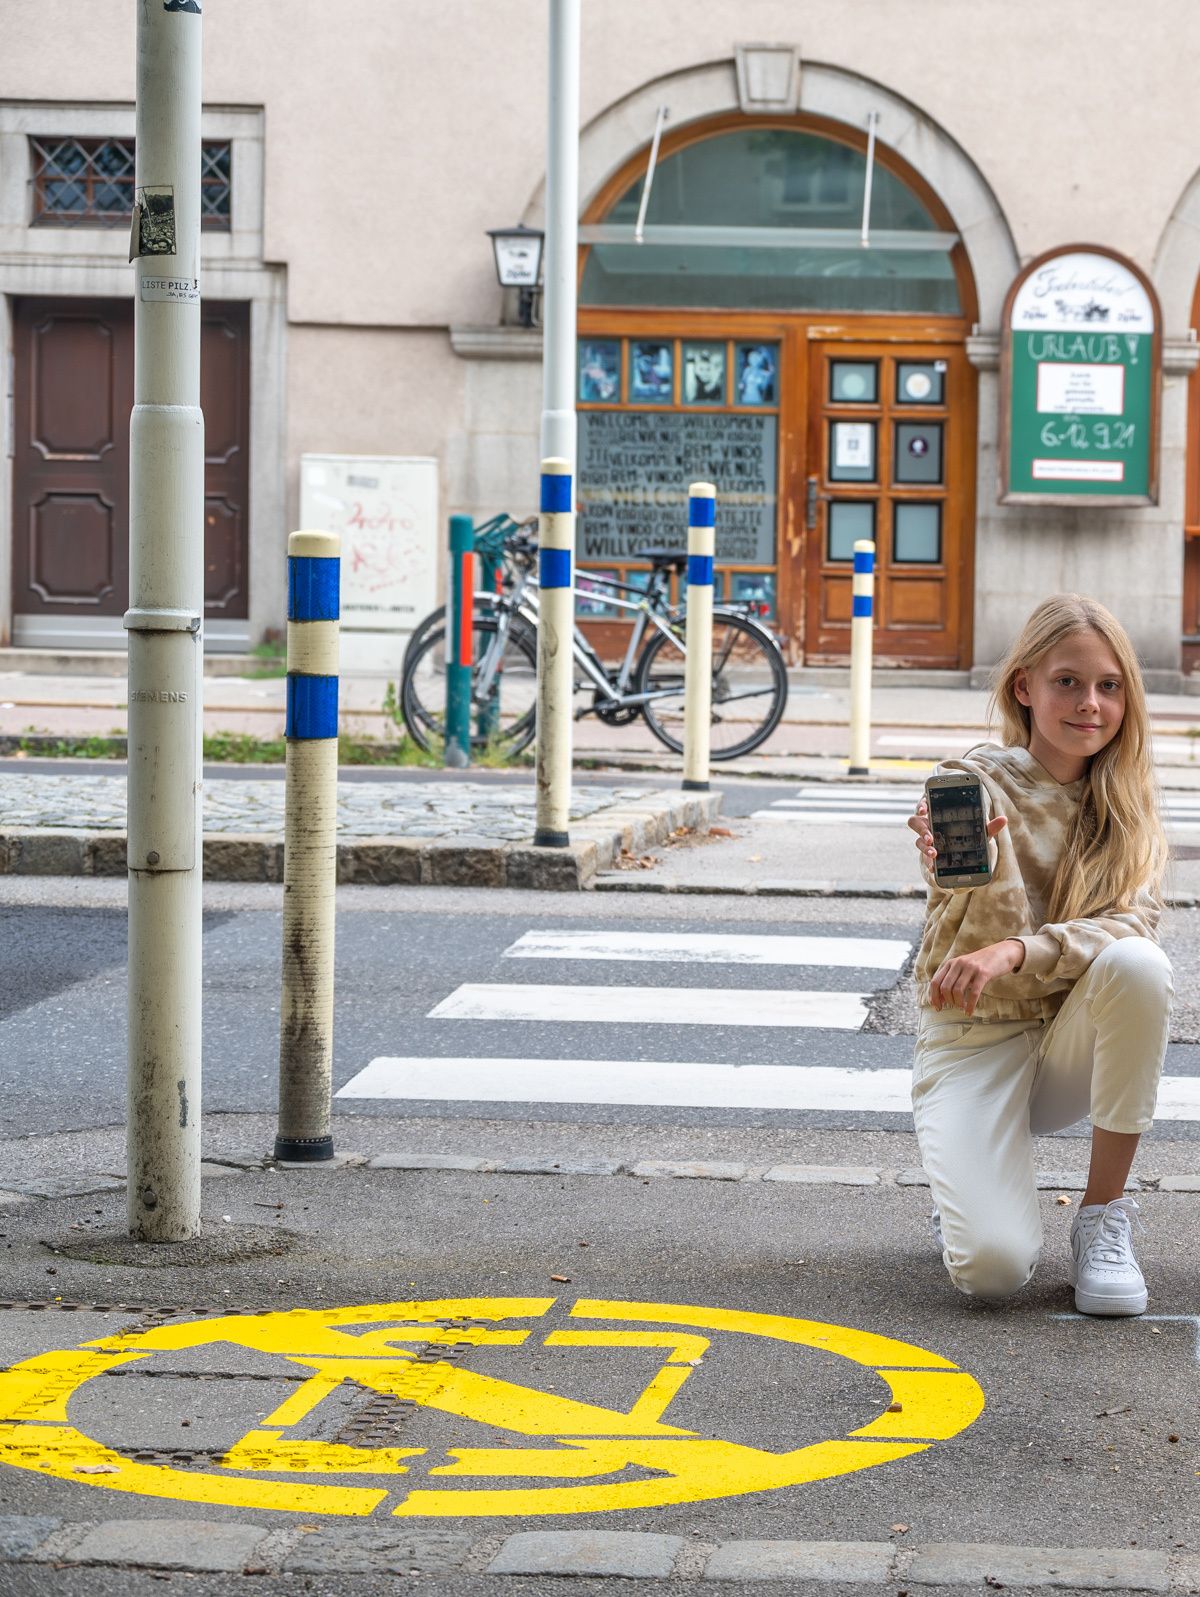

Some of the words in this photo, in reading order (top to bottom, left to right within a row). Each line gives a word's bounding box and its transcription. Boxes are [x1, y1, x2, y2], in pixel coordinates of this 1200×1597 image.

[142, 281, 166, 289] LISTE
[683, 416, 764, 430] WILLKOMMEN
[131, 690, 188, 704] SIEMENS
